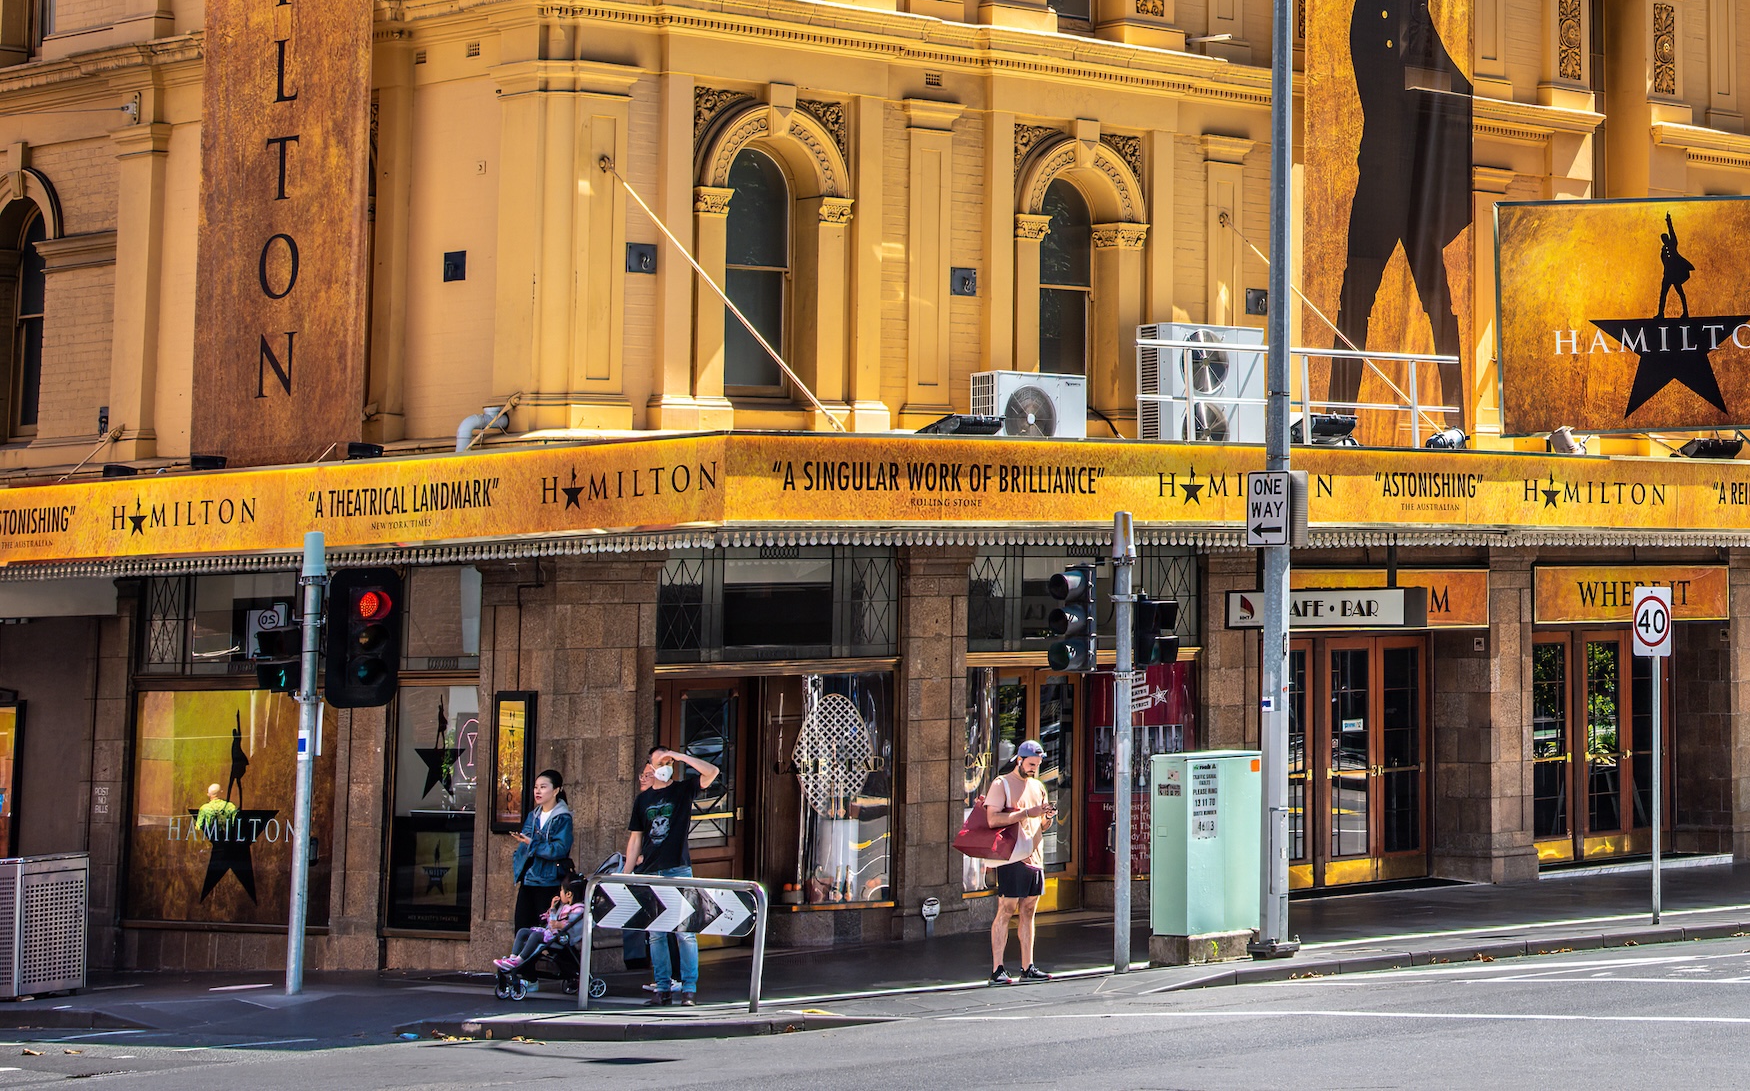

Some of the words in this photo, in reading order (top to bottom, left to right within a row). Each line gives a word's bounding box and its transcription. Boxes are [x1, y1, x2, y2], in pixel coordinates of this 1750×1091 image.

[804, 461, 900, 491] SINGULAR
[906, 463, 962, 492] WORK
[969, 464, 993, 492] OF
[1000, 465, 1105, 496] BRILLIANCE"
[1157, 462, 1334, 506] HAMIN
[1253, 478, 1283, 497] ONE
[1375, 471, 1484, 499] "ASTONISHING"
[328, 486, 408, 517] THEATRICAL
[413, 478, 500, 512] LANDMARK"
[910, 497, 950, 508] ROLLING
[953, 498, 982, 508] STONE
[1251, 500, 1284, 519] WAY
[1401, 503, 1415, 511] THE
[1416, 503, 1460, 512] AUSTRALIAN
[371, 521, 387, 530] NEW
[388, 520, 408, 529] YORK
[410, 518, 432, 528] TIMES
[1, 541, 13, 550] THE
[15, 540, 53, 549] AUSTRALIAN
[1578, 579, 1662, 608] WHE
[1289, 600, 1324, 618] AFE
[1341, 600, 1380, 618] BAR
[1638, 609, 1666, 634] 40
[95, 787, 109, 795] POST
[98, 796, 106, 804] NO
[95, 805, 109, 814] BILLS
[1202, 798, 1208, 806] 11
[1209, 798, 1215, 806] 70
[168, 817, 296, 843] HAMILTON
